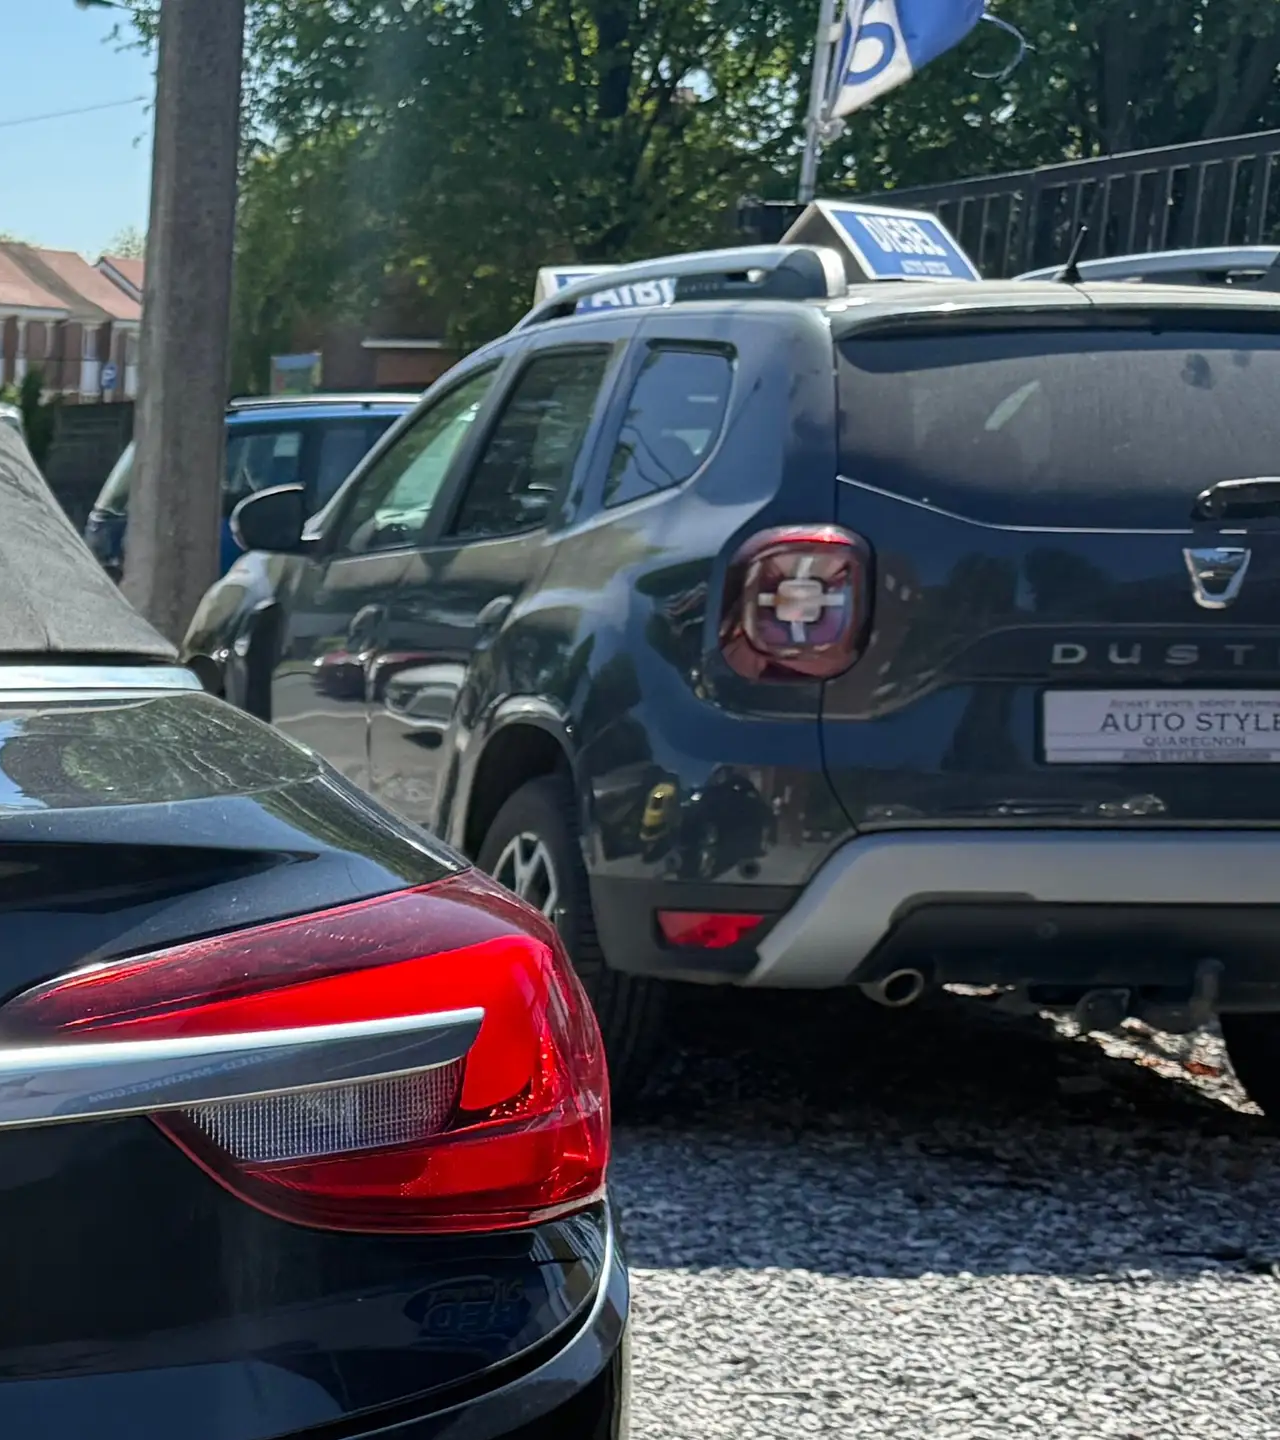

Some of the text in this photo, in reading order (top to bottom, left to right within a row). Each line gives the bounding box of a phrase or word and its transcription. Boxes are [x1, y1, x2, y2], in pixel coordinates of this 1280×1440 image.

[1050, 642, 1280, 666] DUST
[1100, 711, 1186, 733] AUTO
[1142, 735, 1247, 748] QUAREGNON
